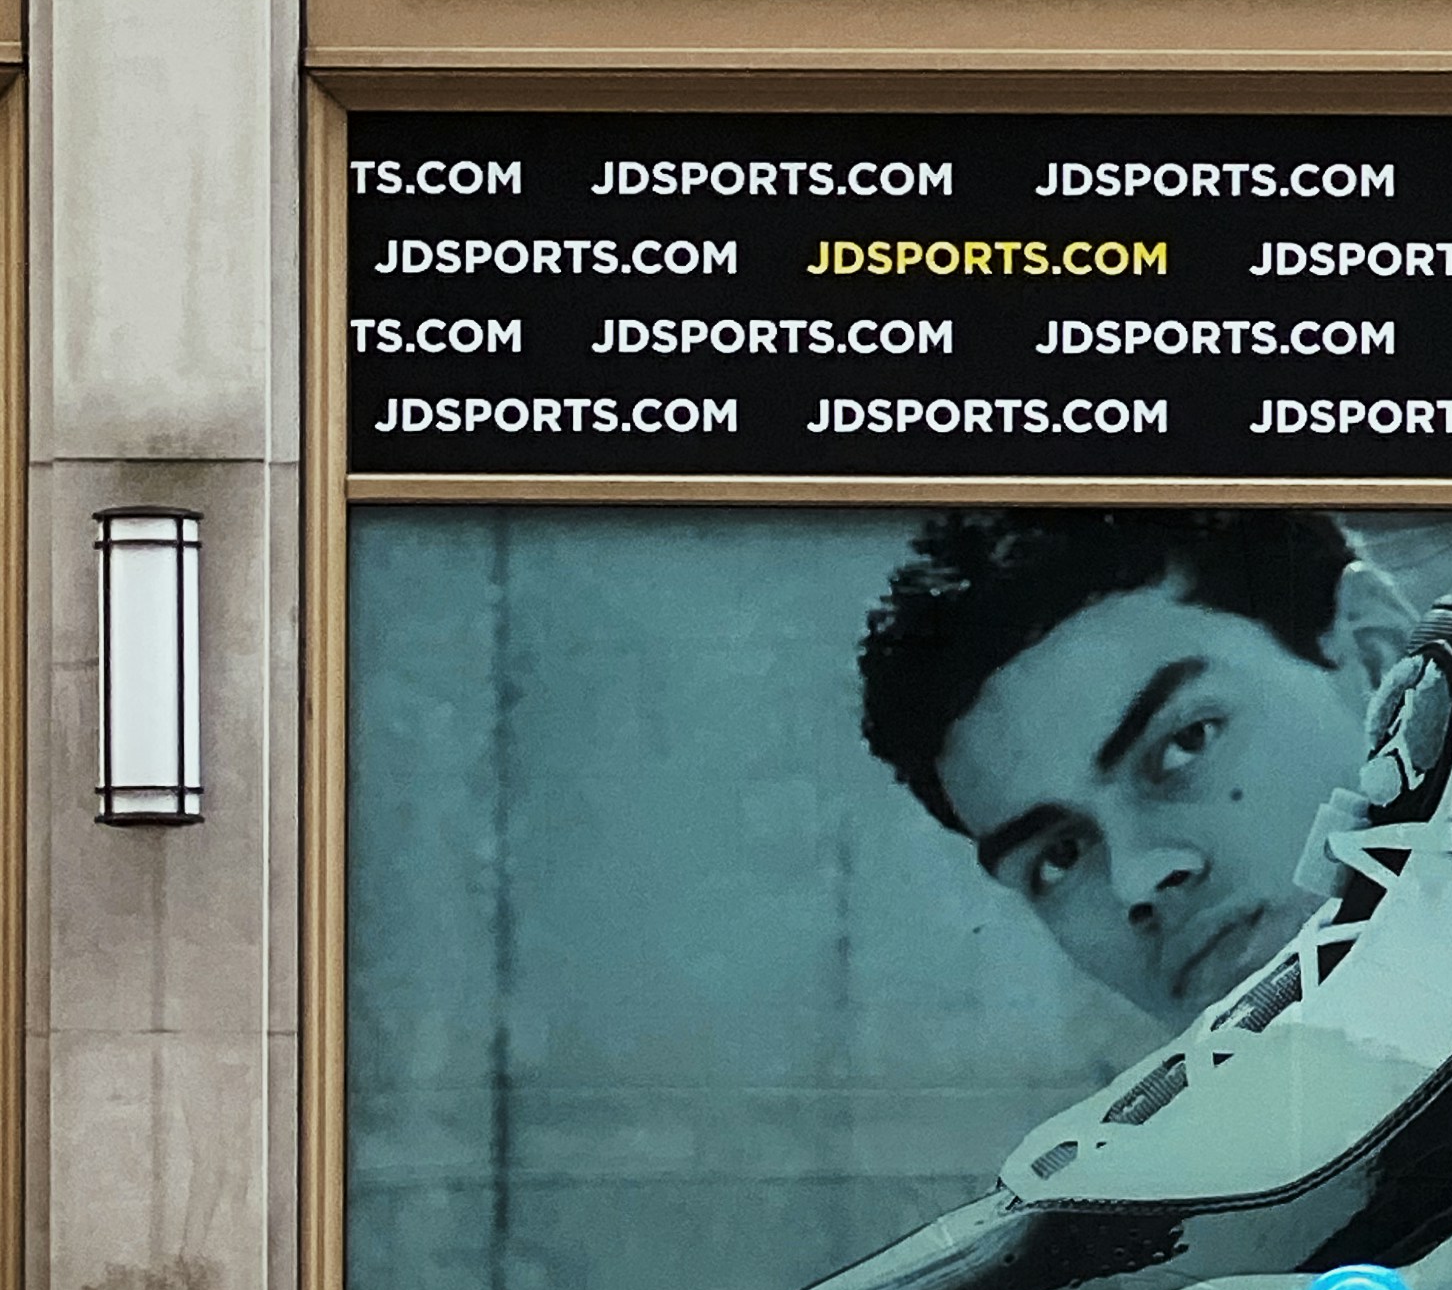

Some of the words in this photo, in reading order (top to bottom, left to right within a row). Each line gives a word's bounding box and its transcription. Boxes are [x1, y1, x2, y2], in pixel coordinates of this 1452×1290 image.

[590, 161, 953, 196] JDSPORTS.COM
[1035, 163, 1395, 198] JDSPORTS.COM
[374, 239, 738, 275] JDSPORTS.COM
[806, 241, 1167, 276] JDSPORTS.COM
[591, 319, 953, 354] JDSPORTS.COM
[1035, 320, 1395, 355] JDSPORTS.COM
[374, 397, 738, 433] JDSPORTS.COM
[806, 398, 1168, 434] JDSPORTS.COM
